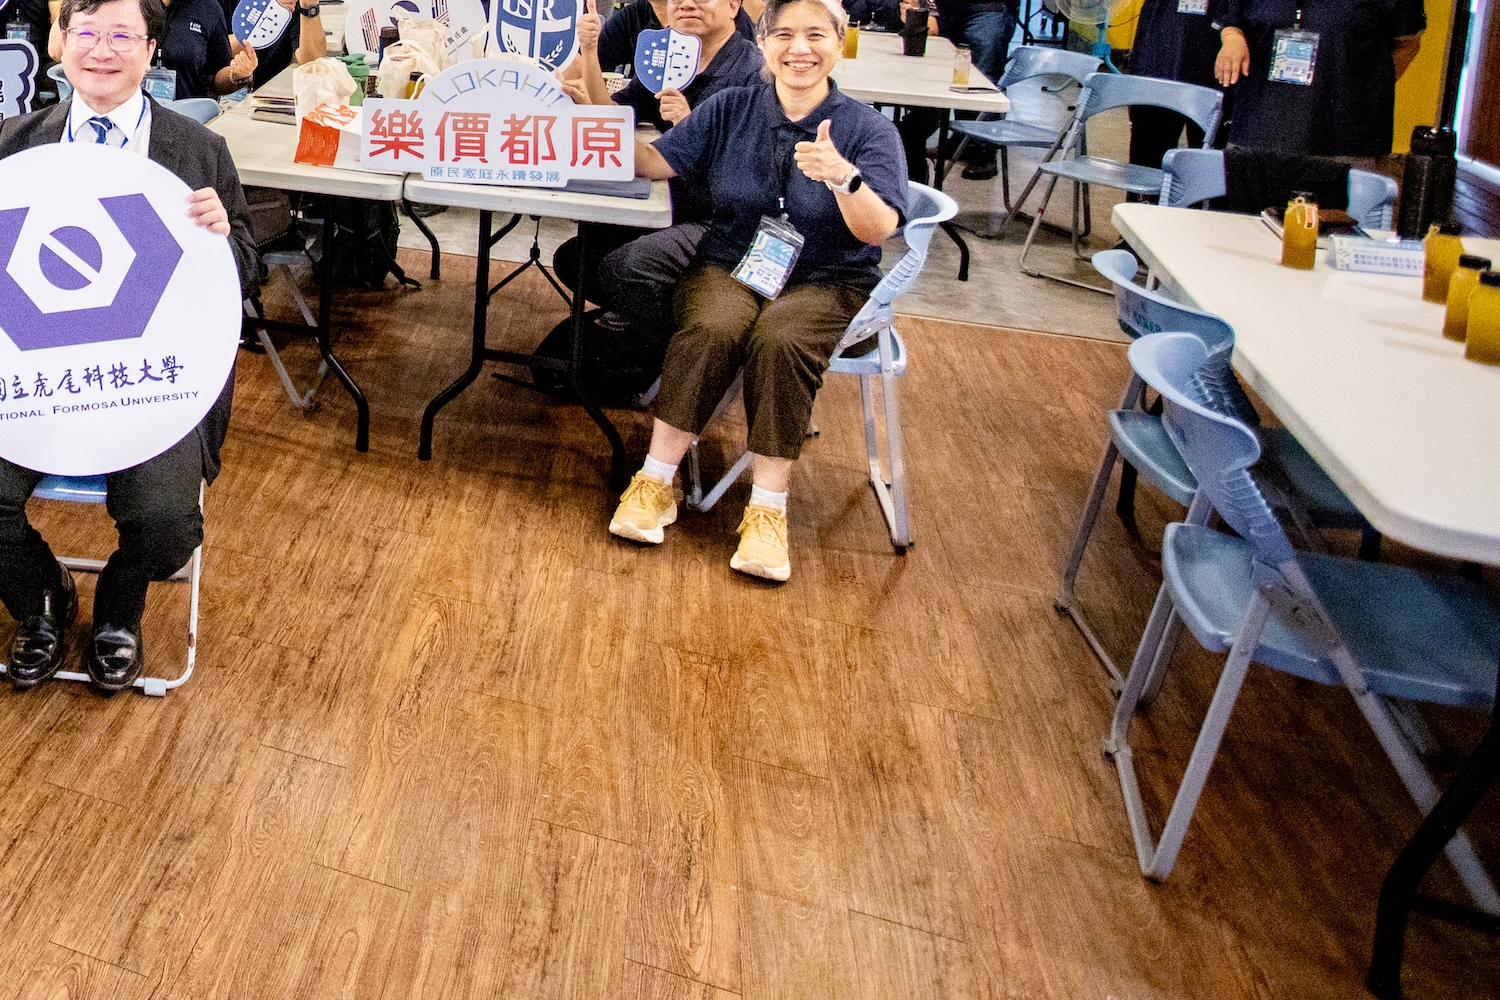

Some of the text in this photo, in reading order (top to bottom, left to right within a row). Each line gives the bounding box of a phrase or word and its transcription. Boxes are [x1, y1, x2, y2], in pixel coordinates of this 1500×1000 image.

[431, 69, 564, 107] LOKAH!!
[369, 109, 625, 168] 樂價都原
[430, 166, 560, 183] 原民家庭永續發展
[52, 401, 118, 415] FORMOSA
[119, 390, 200, 407] UNIVERSITY
